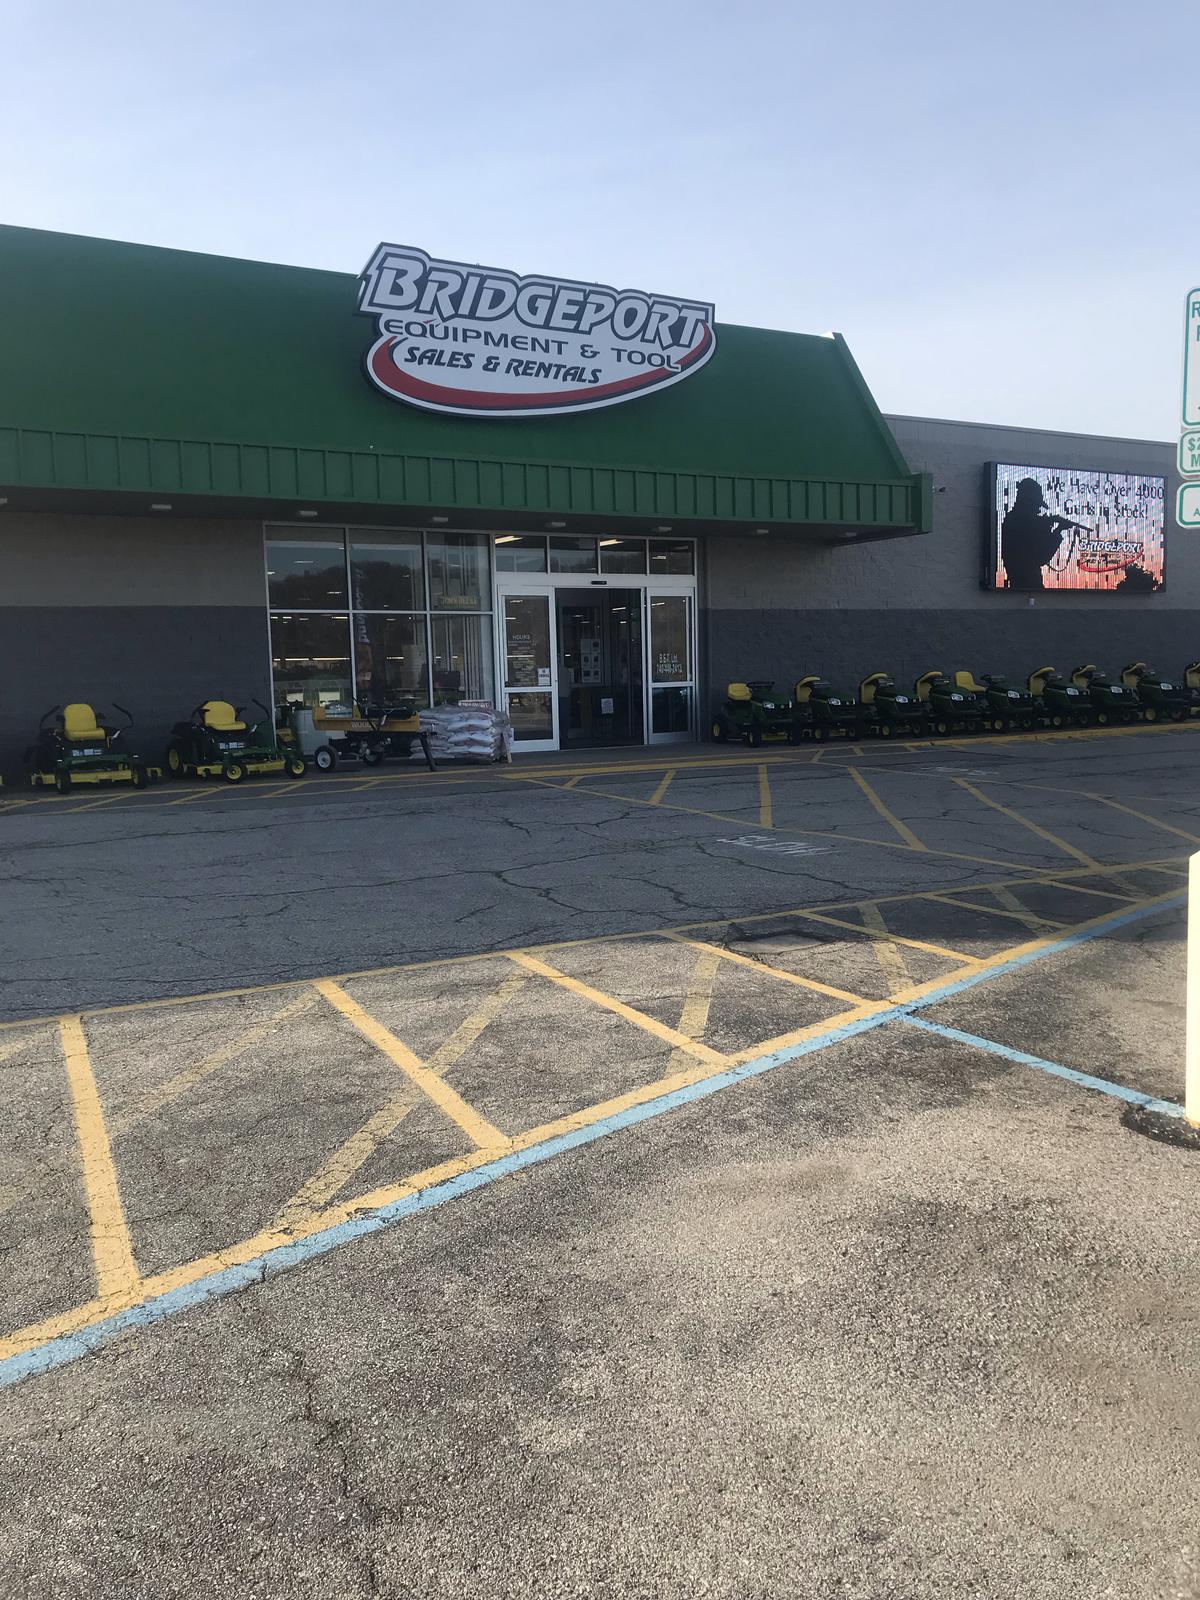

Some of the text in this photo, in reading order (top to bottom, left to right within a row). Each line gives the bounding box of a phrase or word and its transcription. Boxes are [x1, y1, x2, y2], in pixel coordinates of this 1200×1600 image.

[373, 255, 706, 350] BRIDGEPORT
[384, 318, 681, 371] EQUIPMENT & TOOL
[404, 346, 602, 384] SALES & RENTALS
[1070, 478, 1099, 495] Have
[1105, 480, 1131, 497] Over
[1136, 484, 1164, 500] 4000
